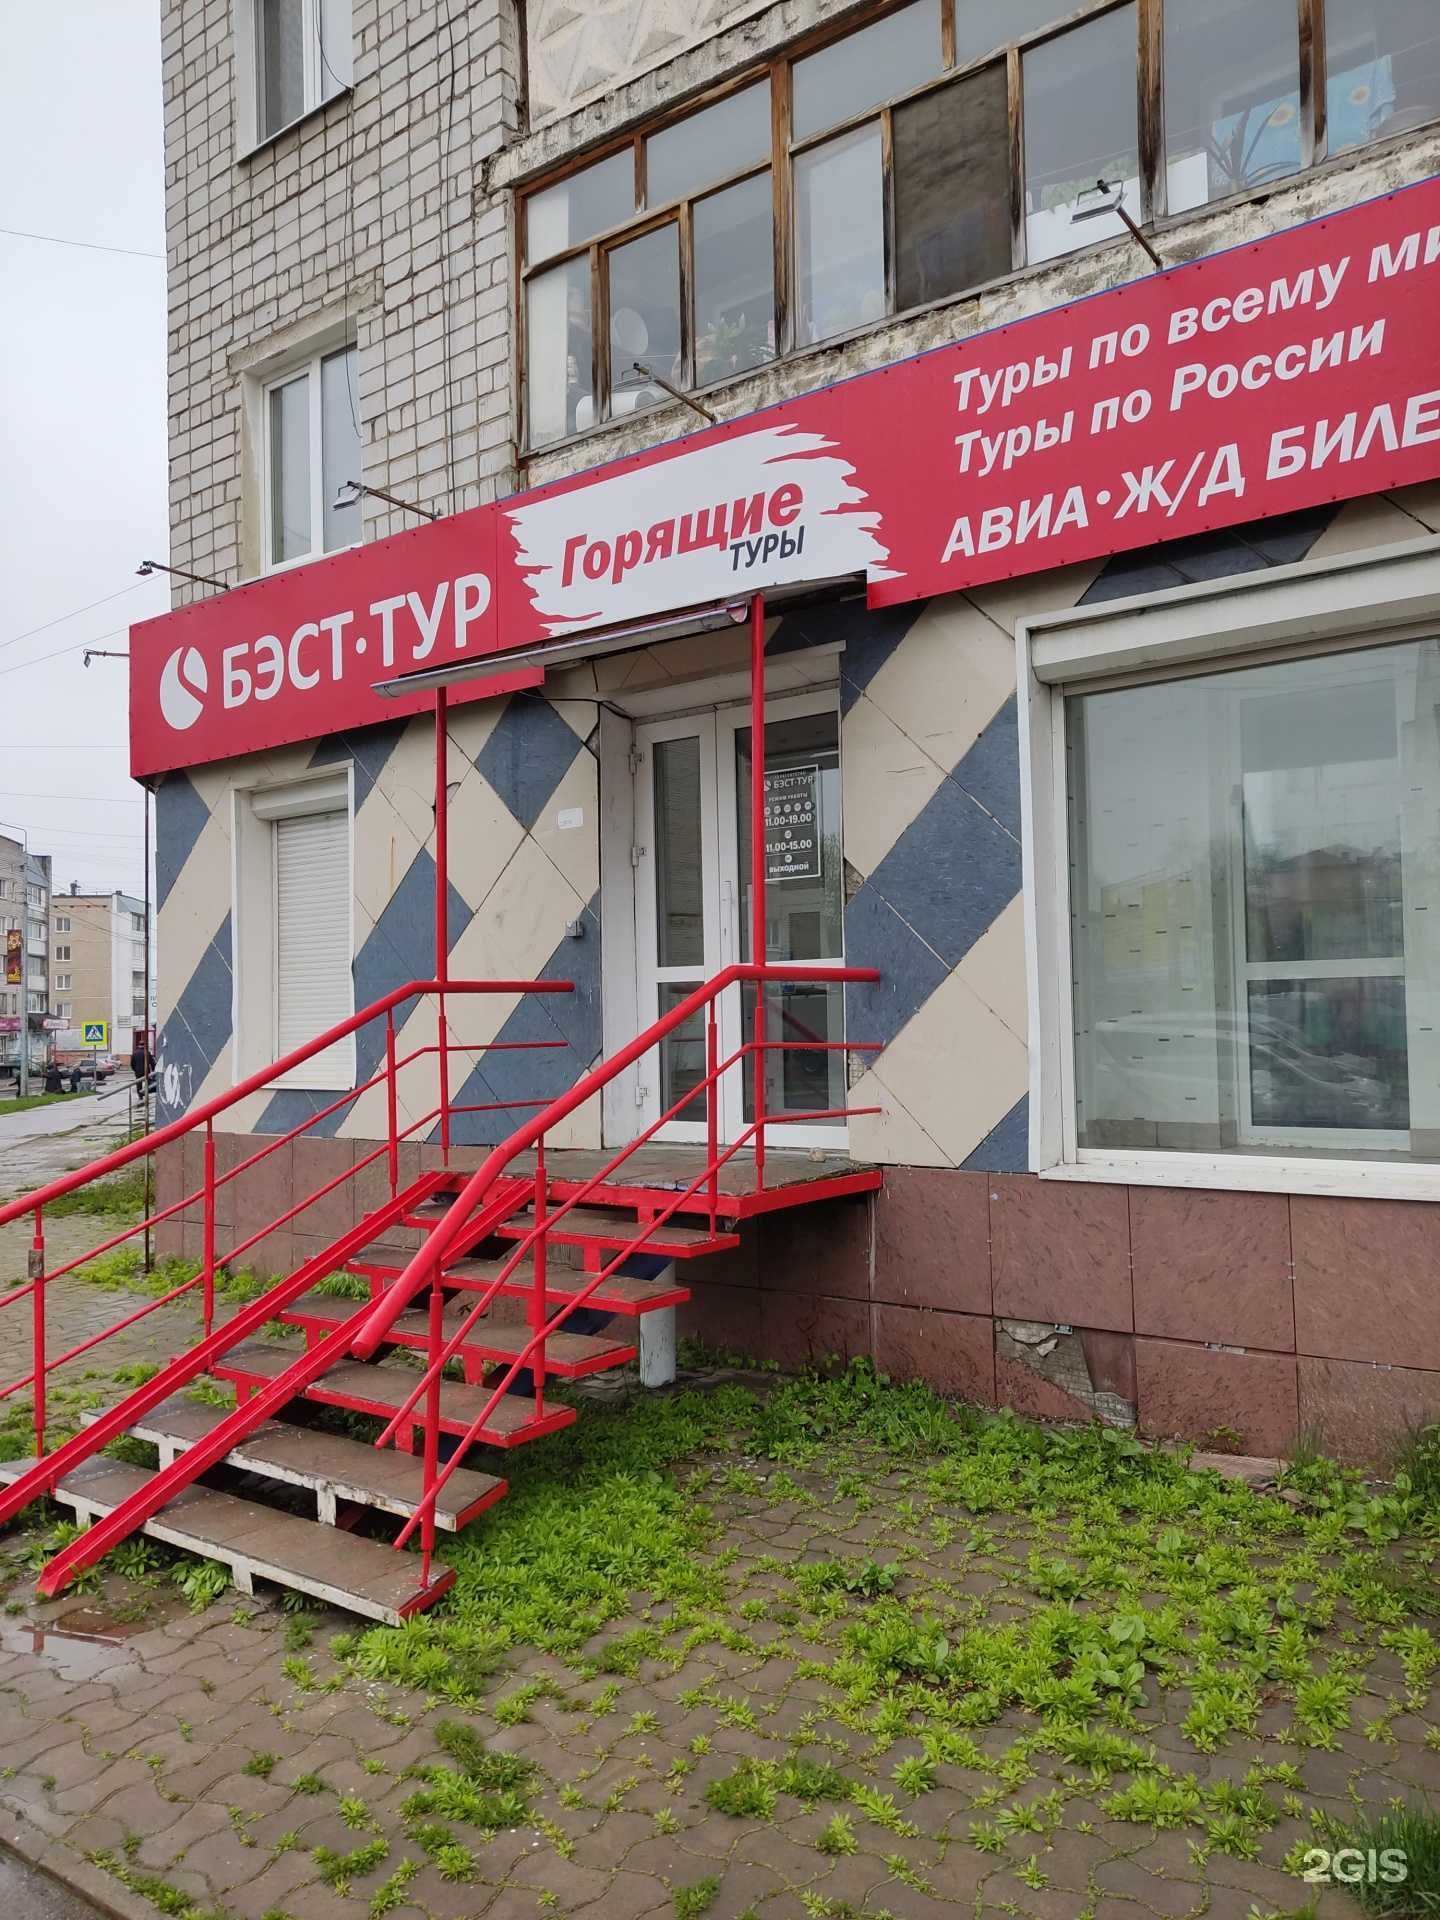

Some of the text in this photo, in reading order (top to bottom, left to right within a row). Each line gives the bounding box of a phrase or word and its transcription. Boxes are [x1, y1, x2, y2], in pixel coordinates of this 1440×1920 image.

[953, 347, 1073, 415] Туры
[1088, 323, 1151, 370] по
[1167, 256, 1351, 345] всему
[954, 318, 1386, 477] Туры по России
[561, 483, 804, 588] Горящие
